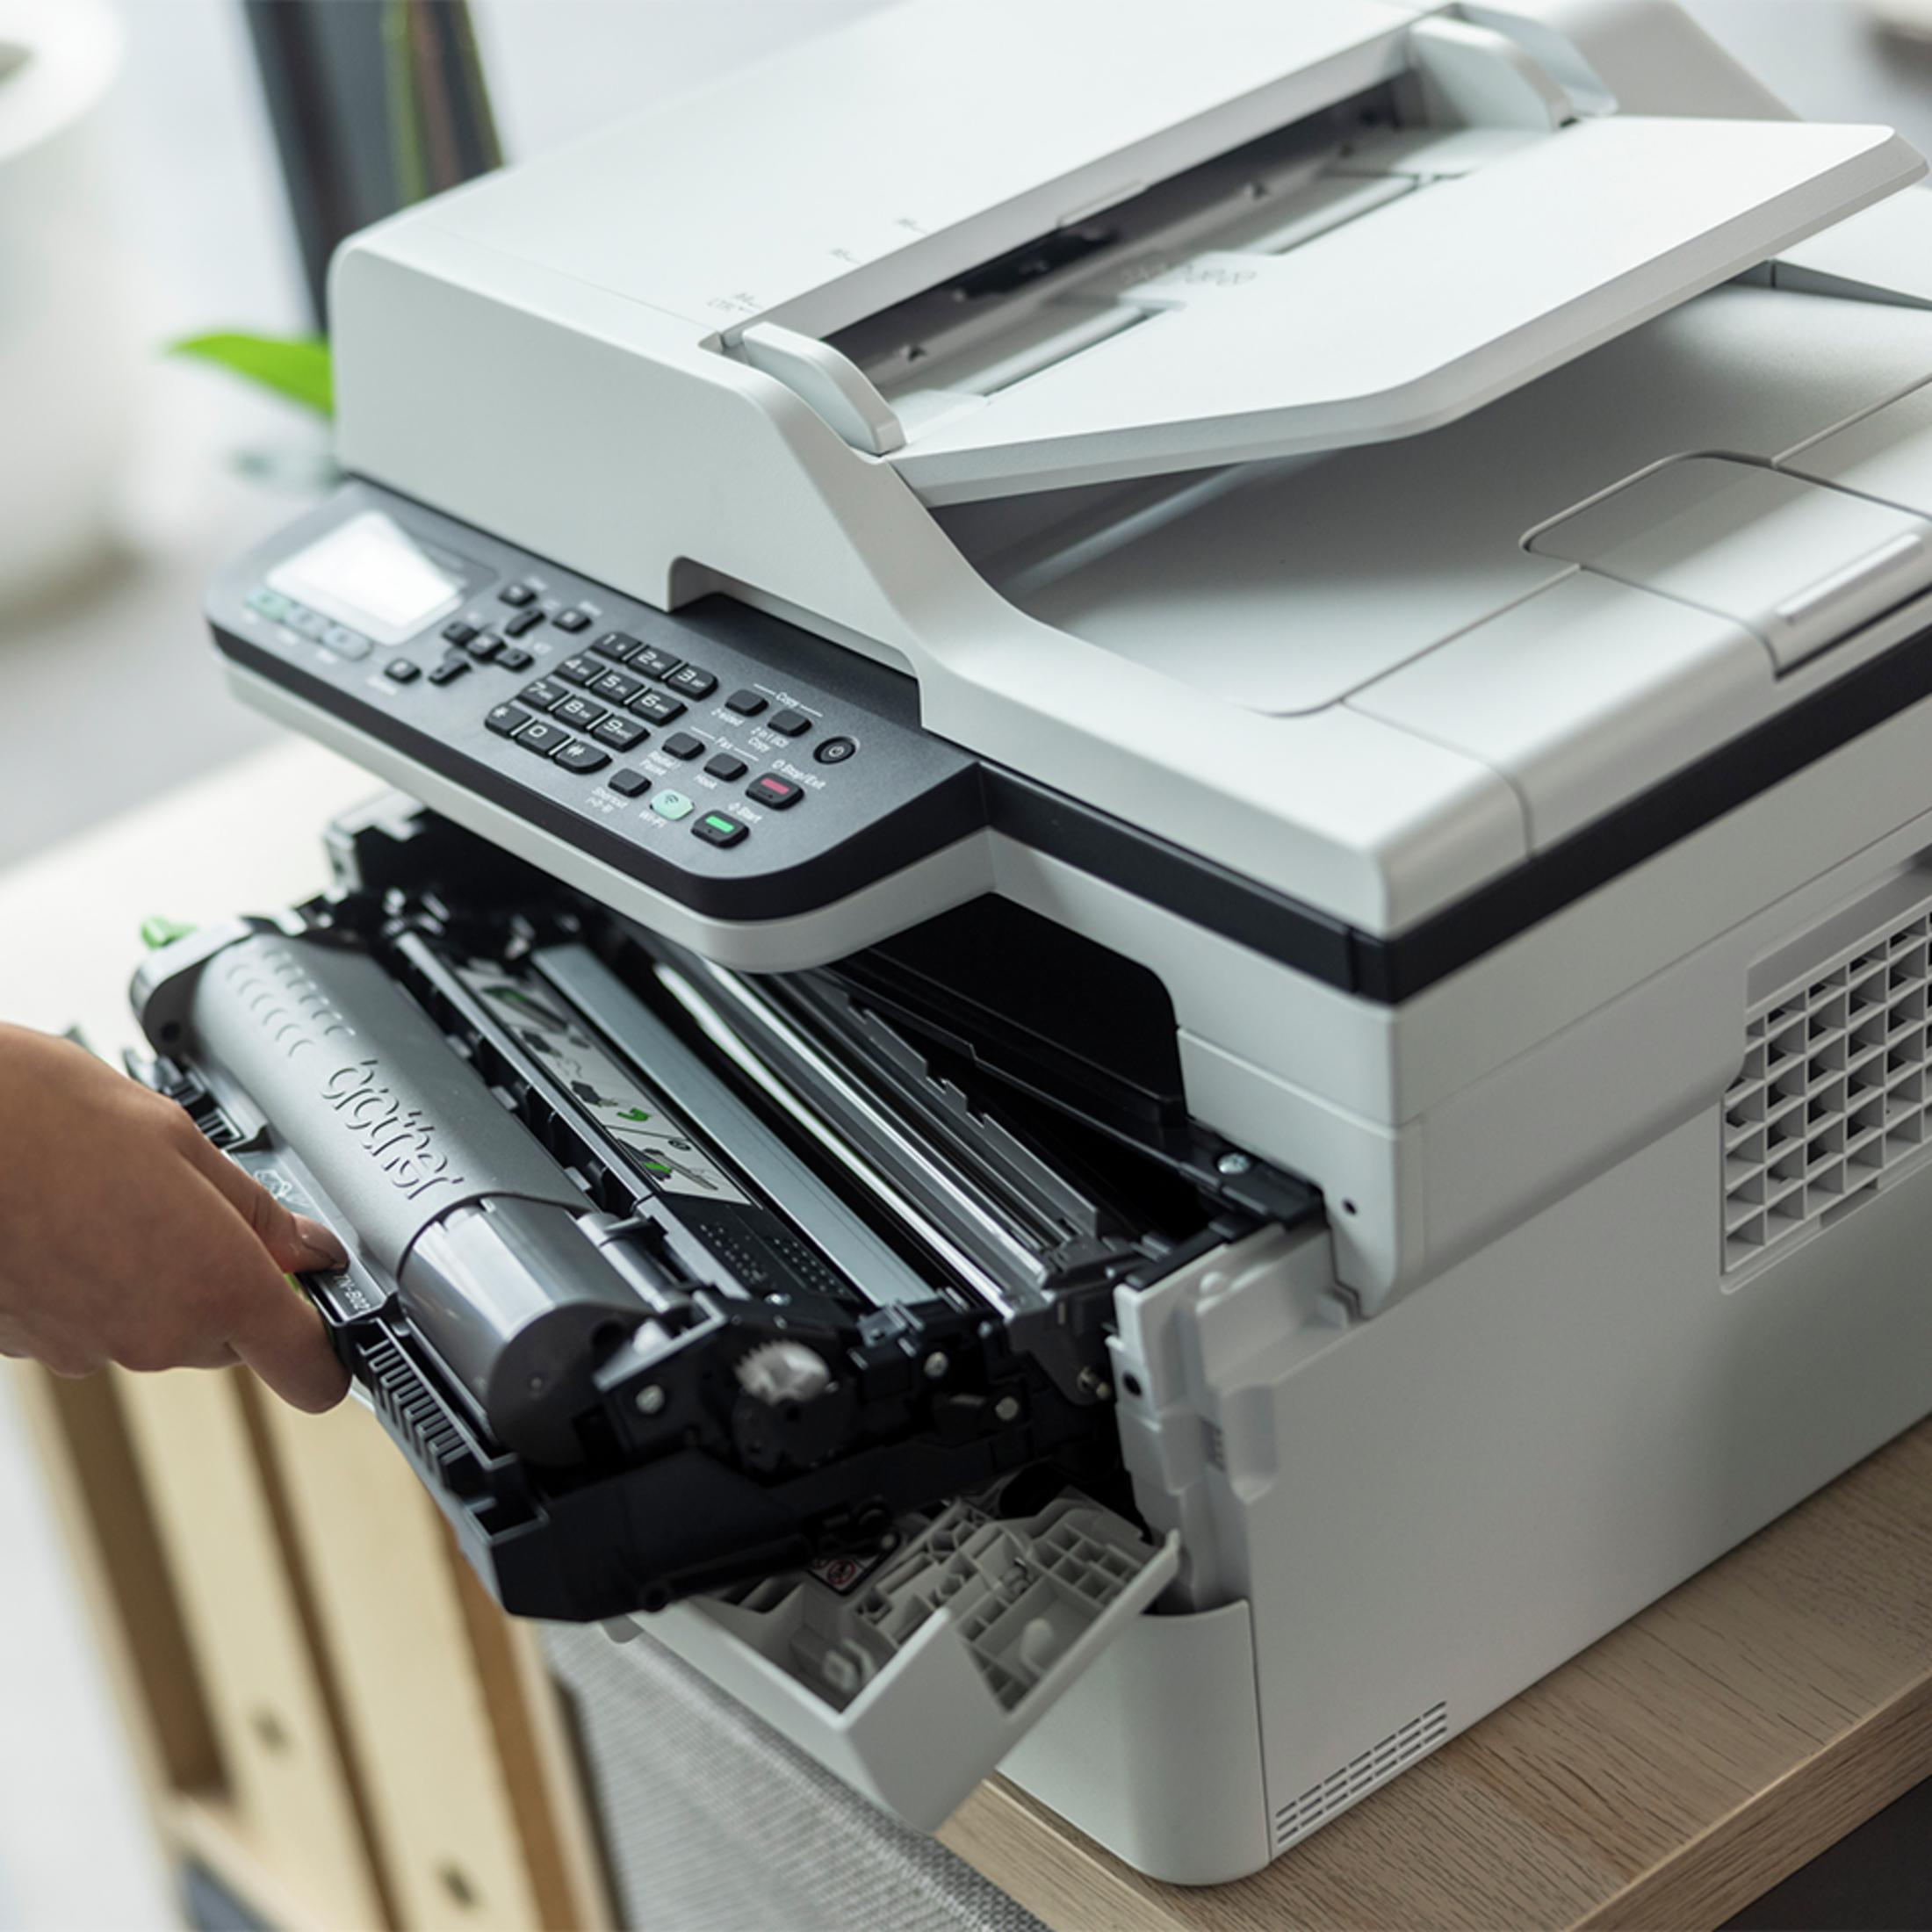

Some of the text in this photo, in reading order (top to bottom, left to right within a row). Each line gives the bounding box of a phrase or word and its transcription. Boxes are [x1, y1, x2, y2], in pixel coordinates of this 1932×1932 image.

[602, 634, 616, 645] 1
[565, 659, 583, 671] 4
[637, 651, 657, 665] 2
[602, 674, 622, 688] 5
[676, 668, 697, 682] 3
[528, 681, 547, 693] 7
[565, 700, 585, 713] 8
[641, 693, 661, 708] 6
[776, 692, 800, 710] Copy
[528, 724, 549, 739] 0
[603, 719, 624, 732] 9
